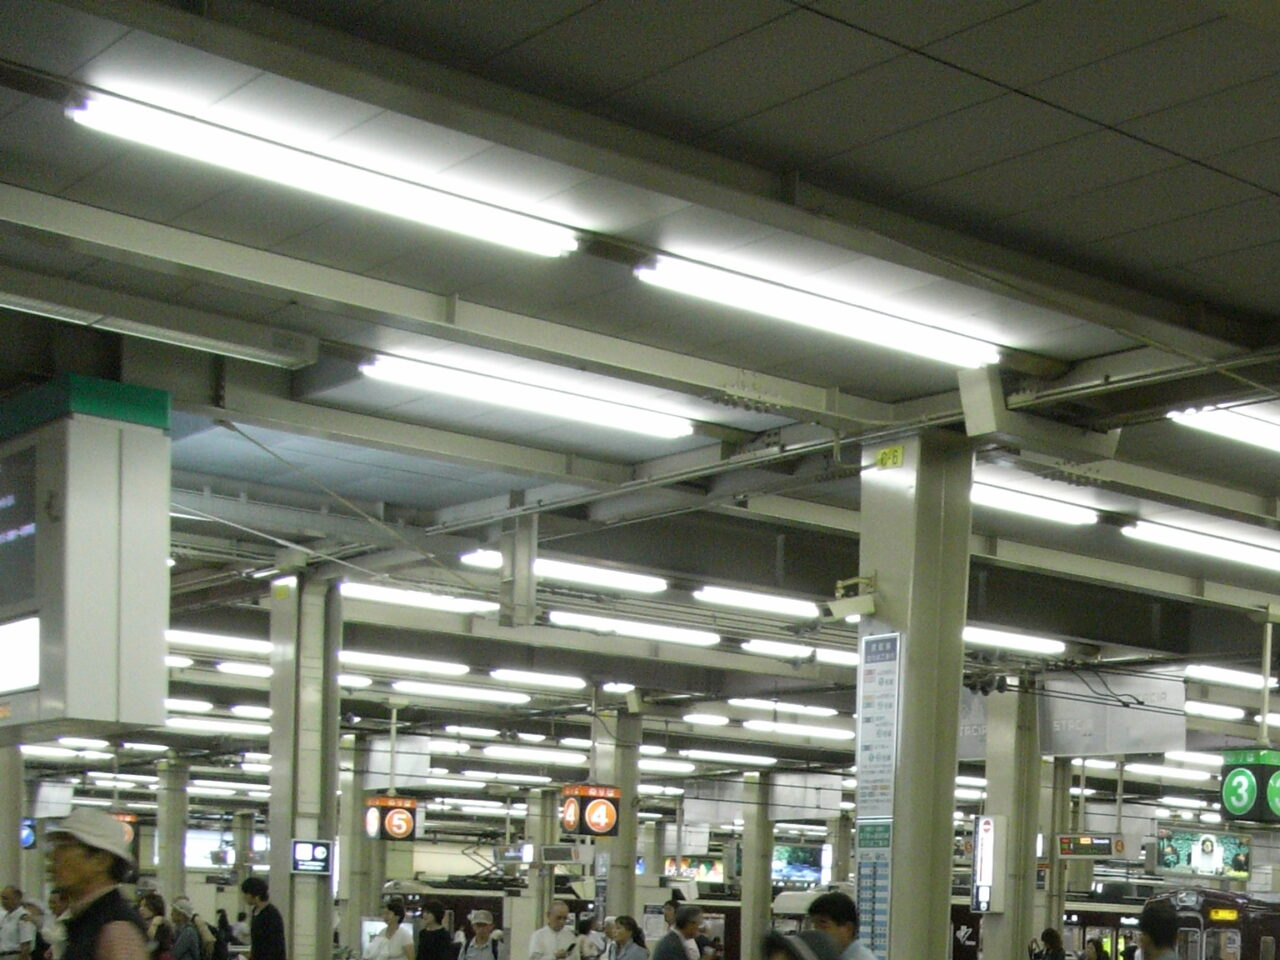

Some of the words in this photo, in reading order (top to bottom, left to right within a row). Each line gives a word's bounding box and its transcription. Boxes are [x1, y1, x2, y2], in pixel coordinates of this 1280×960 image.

[1231, 776, 1248, 807] 3
[392, 814, 407, 834] 5
[565, 802, 576, 825] 4
[591, 804, 609, 827] 4
